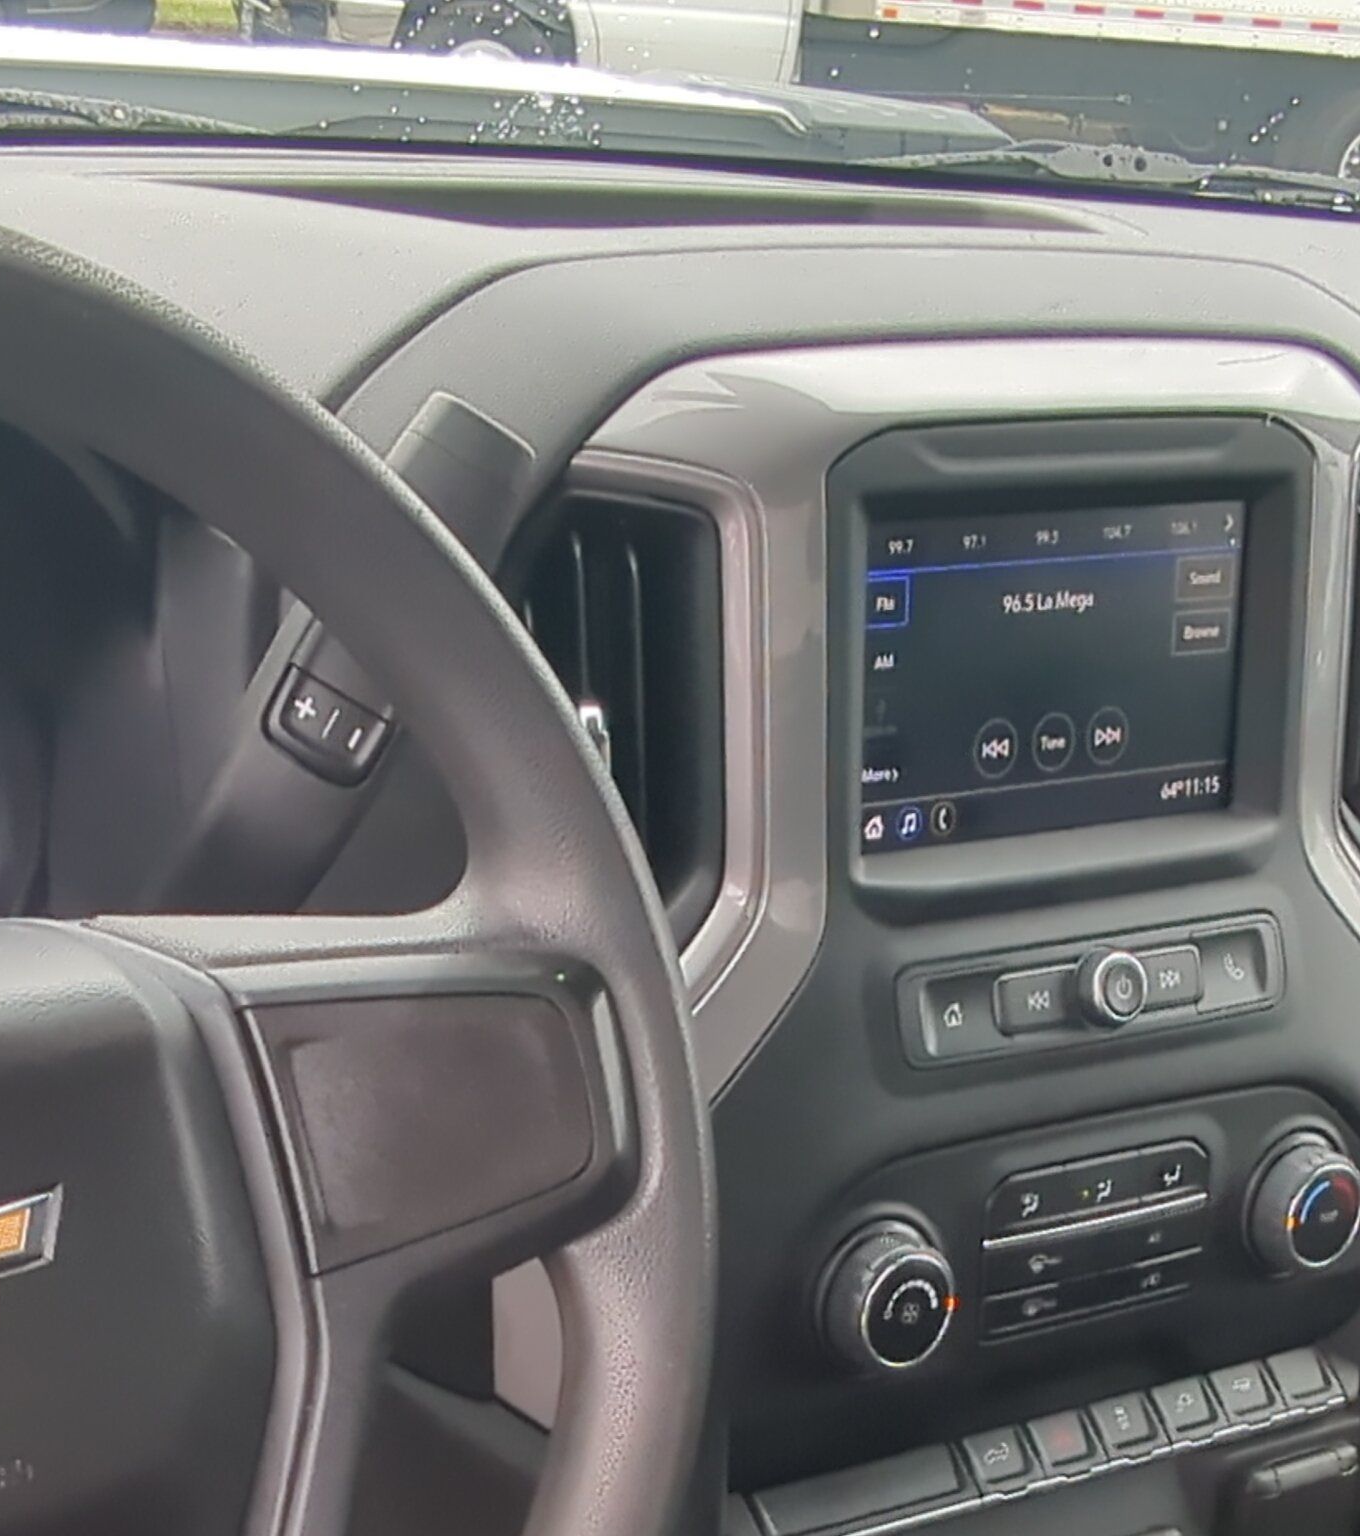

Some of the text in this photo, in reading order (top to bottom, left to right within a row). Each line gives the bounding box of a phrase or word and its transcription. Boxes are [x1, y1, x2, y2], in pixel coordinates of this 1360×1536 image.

[1003, 588, 1095, 614] 96.5 La Mega
[874, 654, 895, 670] AM
[1041, 734, 1067, 751] Tune
[861, 767, 891, 783] More
[1186, 774, 1220, 797] 11:15
